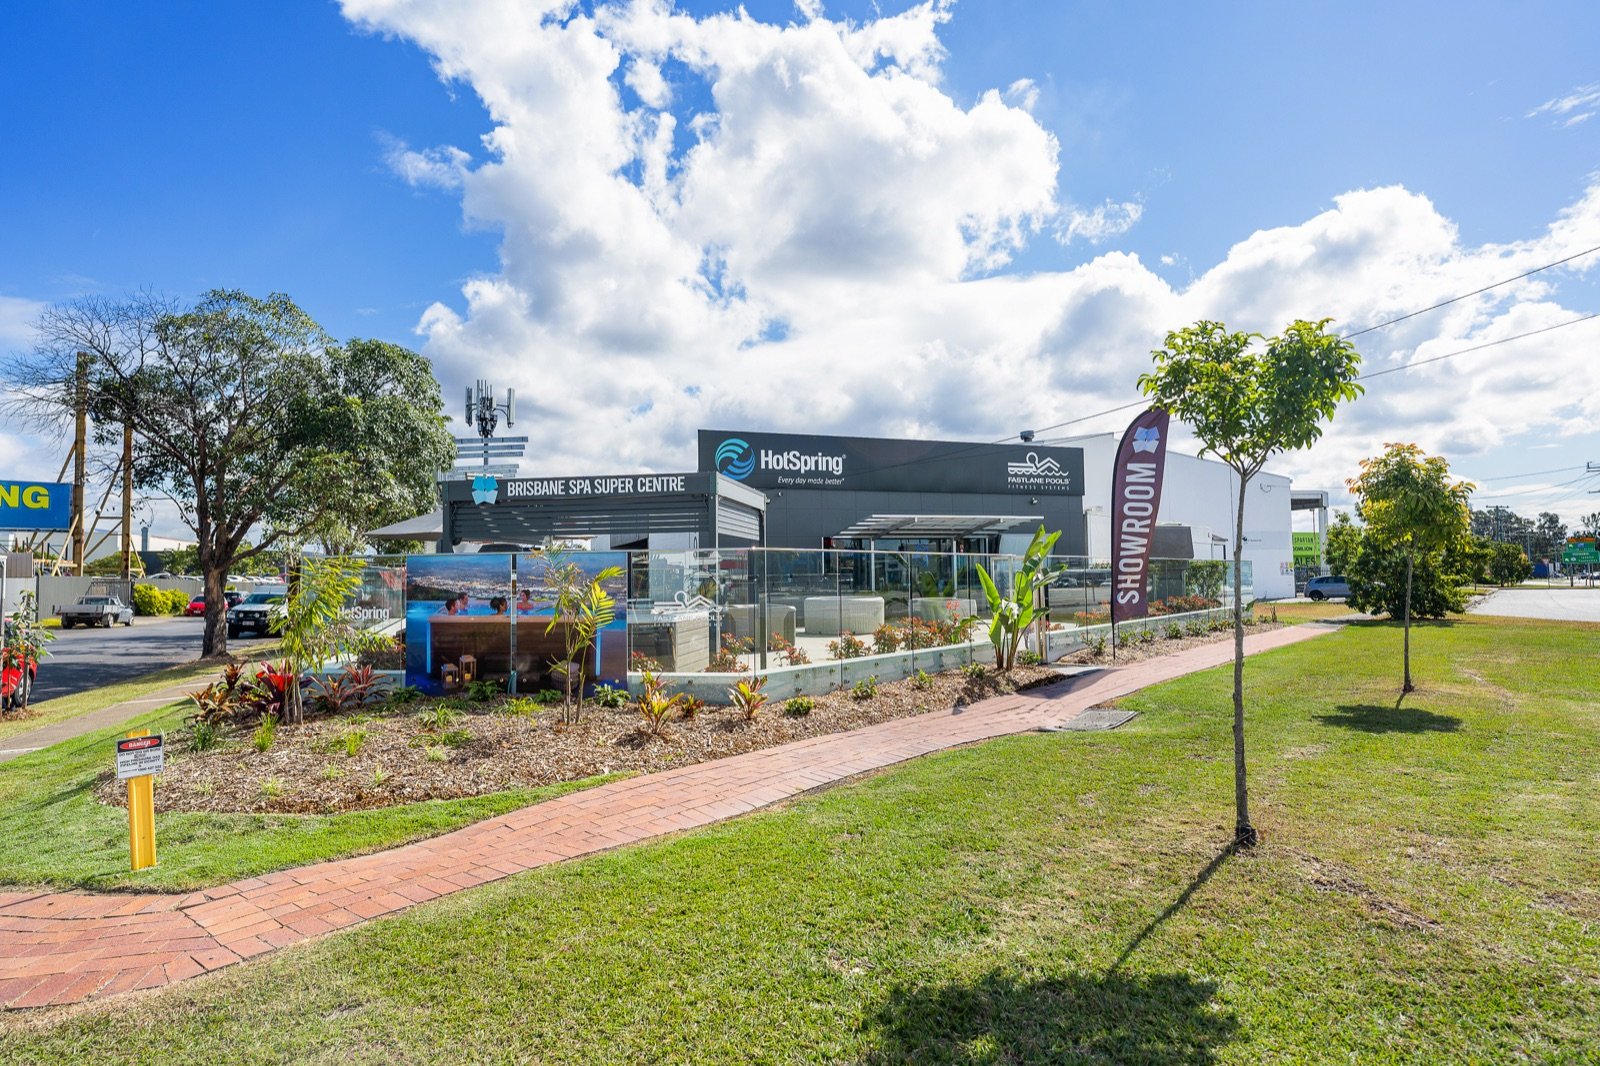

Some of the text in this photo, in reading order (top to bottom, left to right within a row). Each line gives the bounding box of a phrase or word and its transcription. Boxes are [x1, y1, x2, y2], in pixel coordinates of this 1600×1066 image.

[506, 474, 686, 497] BRISBANE SPA SUPER CENTRE
[777, 475, 793, 485] Every
[795, 476, 807, 485] day
[807, 477, 823, 485] made
[1008, 477, 1069, 485] FASTLANE POOLS
[0, 485, 49, 509] NG
[1116, 462, 1157, 605] SHOWROOM
